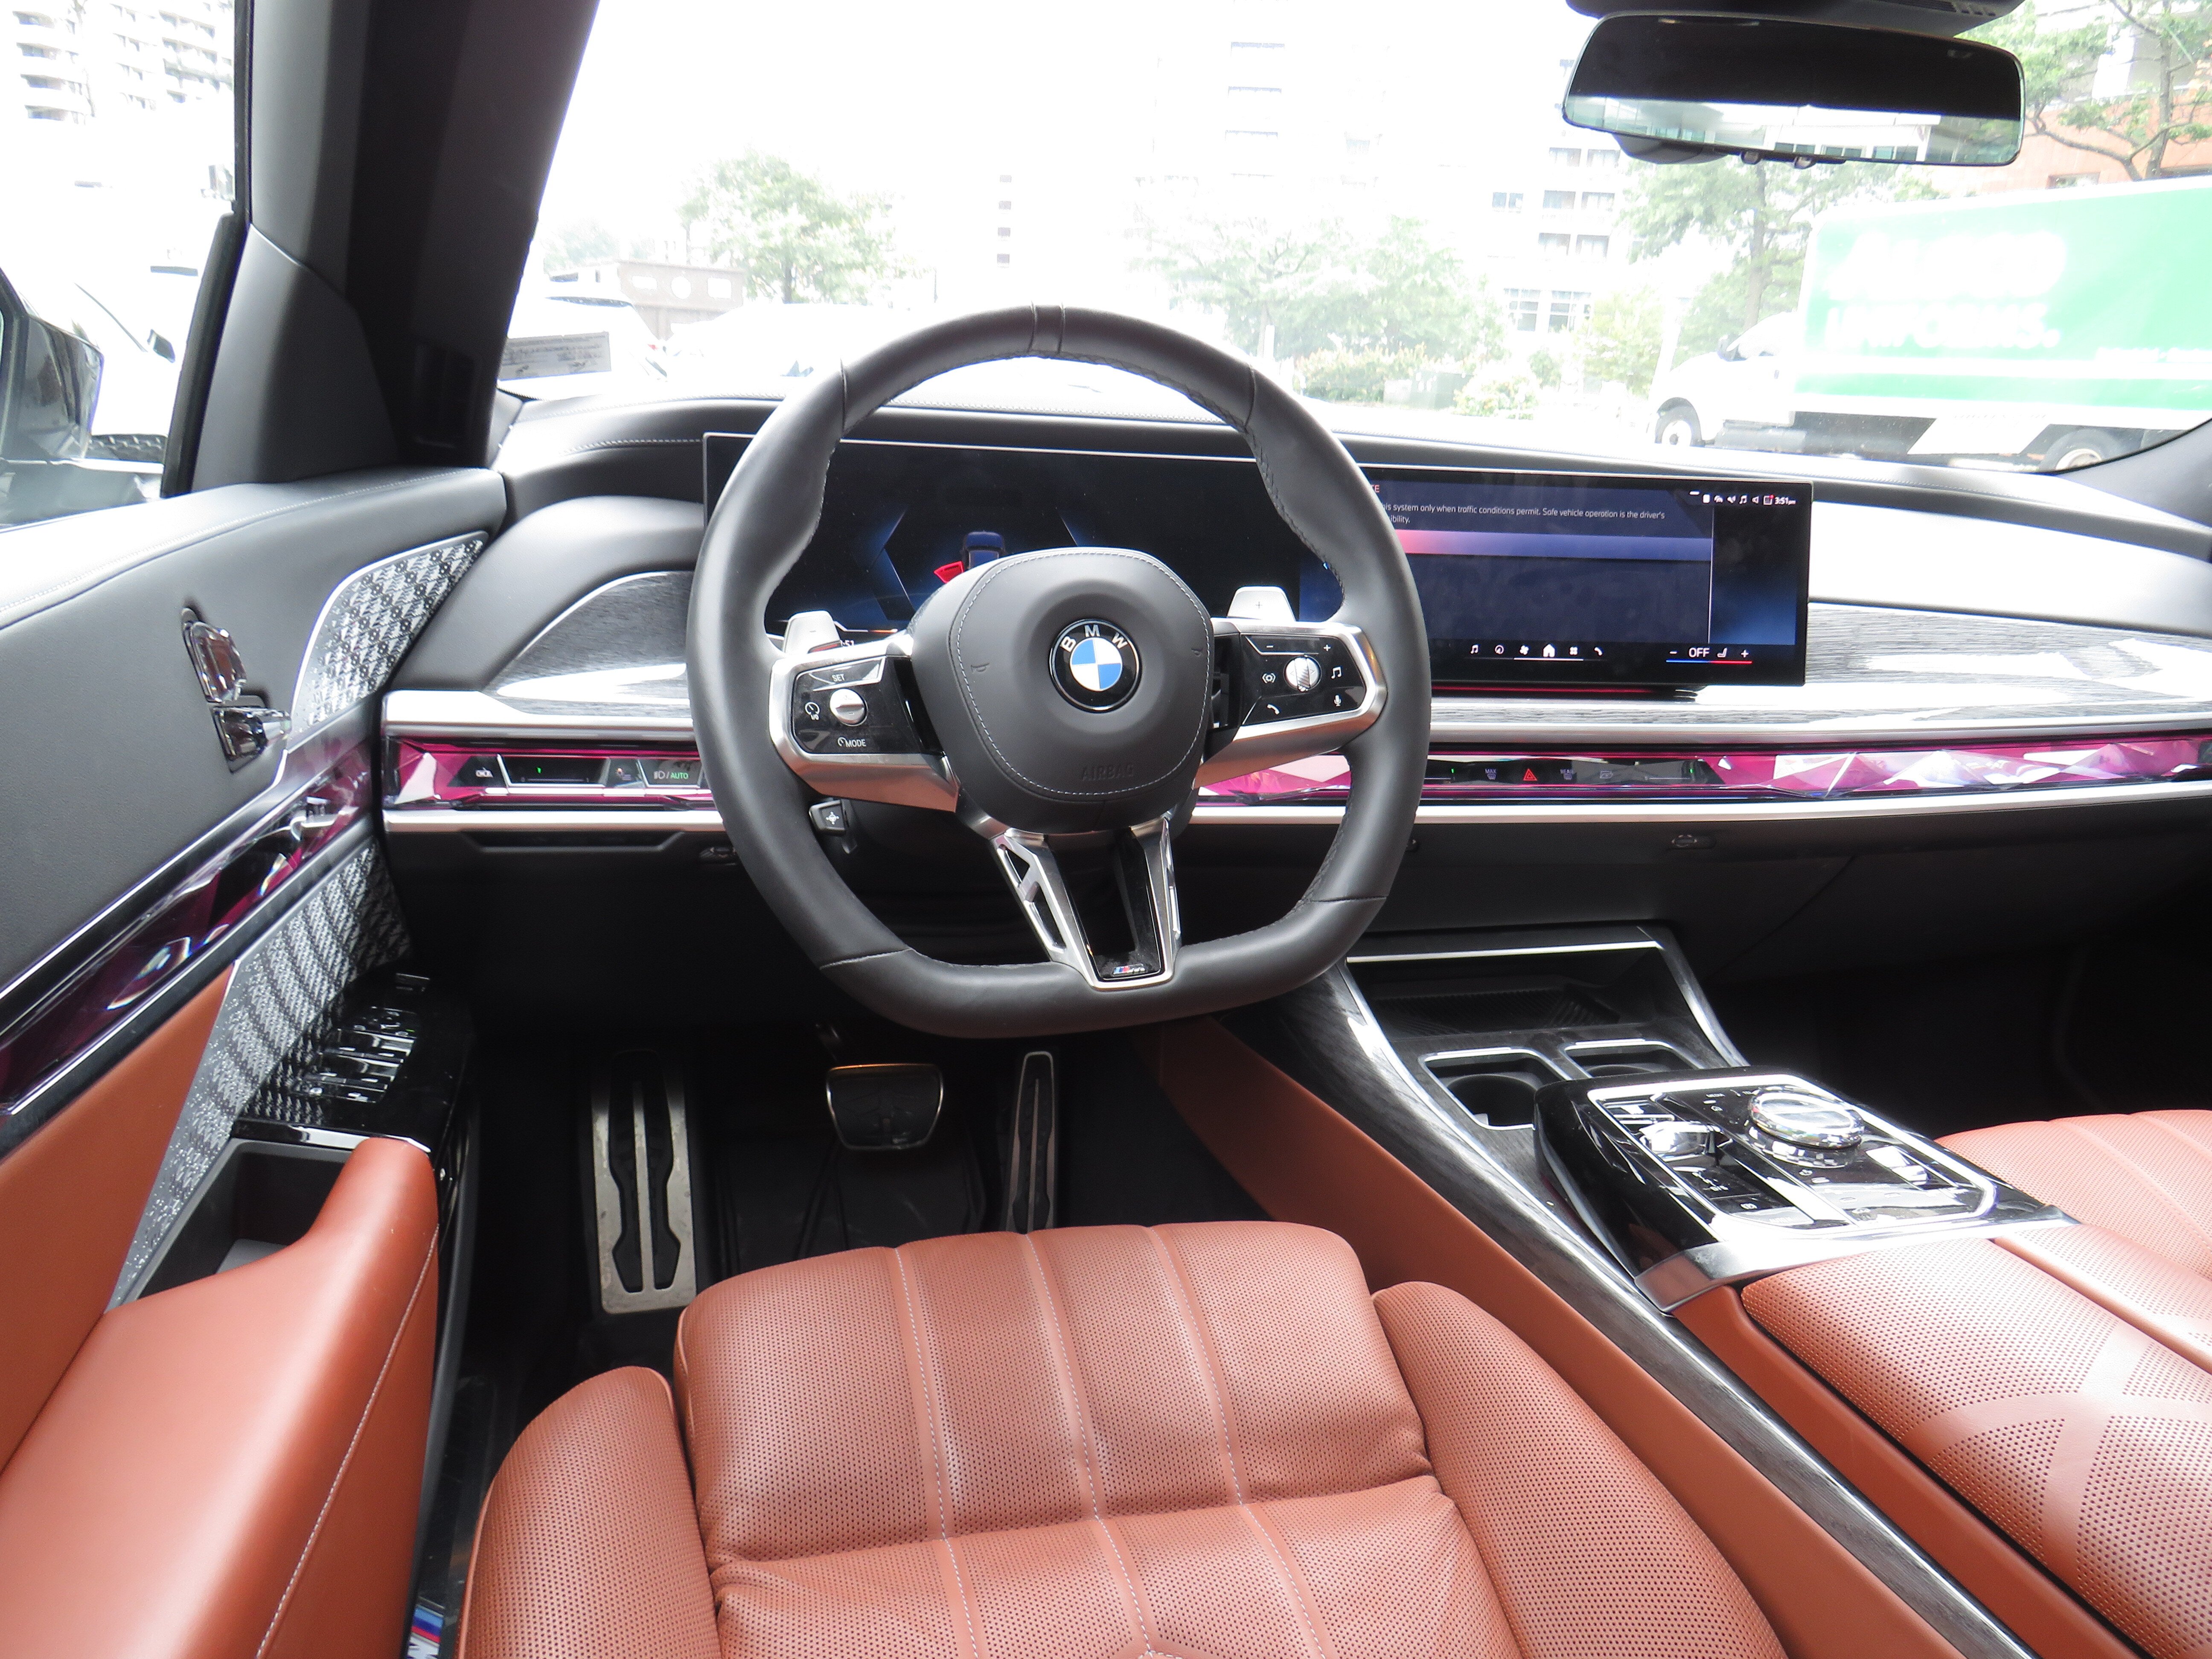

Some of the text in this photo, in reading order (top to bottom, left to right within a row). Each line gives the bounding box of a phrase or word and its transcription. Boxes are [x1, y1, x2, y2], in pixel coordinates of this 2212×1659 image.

[1393, 504, 1418, 514] system
[1420, 504, 1435, 515] only
[1436, 505, 1455, 513] when
[1458, 505, 1477, 514] traffic
[1479, 506, 1514, 515] conditions
[1543, 508, 1558, 516] Safe
[1559, 509, 1583, 517] vehicle
[1585, 509, 1618, 518] operation
[1627, 511, 1638, 519] the
[1640, 510, 1665, 519] driver's
[1060, 624, 1128, 652] BMW
[1689, 648, 1709, 658] OFF
[832, 674, 845, 682] SET
[845, 739, 867, 748] MODE
[670, 771, 689, 779] AUTO
